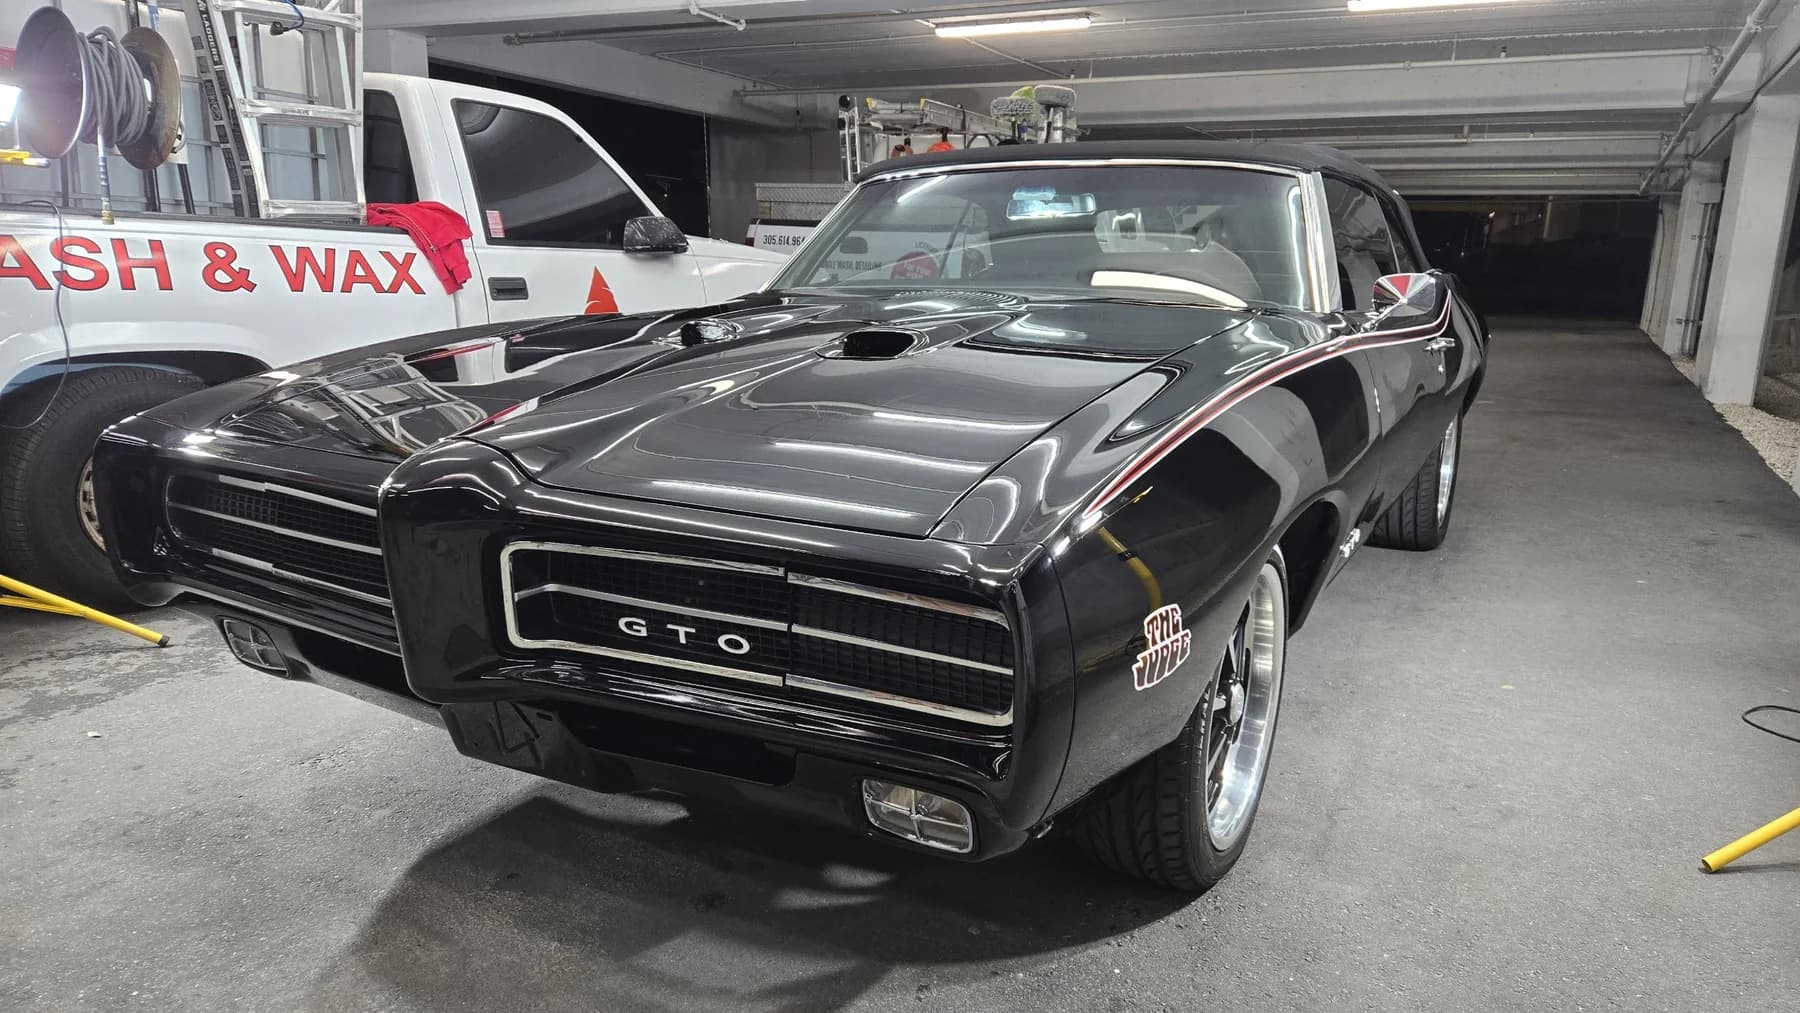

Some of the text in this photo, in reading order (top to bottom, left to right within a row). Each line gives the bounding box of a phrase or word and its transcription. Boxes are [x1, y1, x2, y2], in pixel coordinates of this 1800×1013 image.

[201, 241, 257, 293] &
[268, 245, 426, 295] WAX
[617, 616, 751, 655] GTO
[1145, 605, 1182, 648] THE
[1133, 632, 1190, 689] JUDGE
